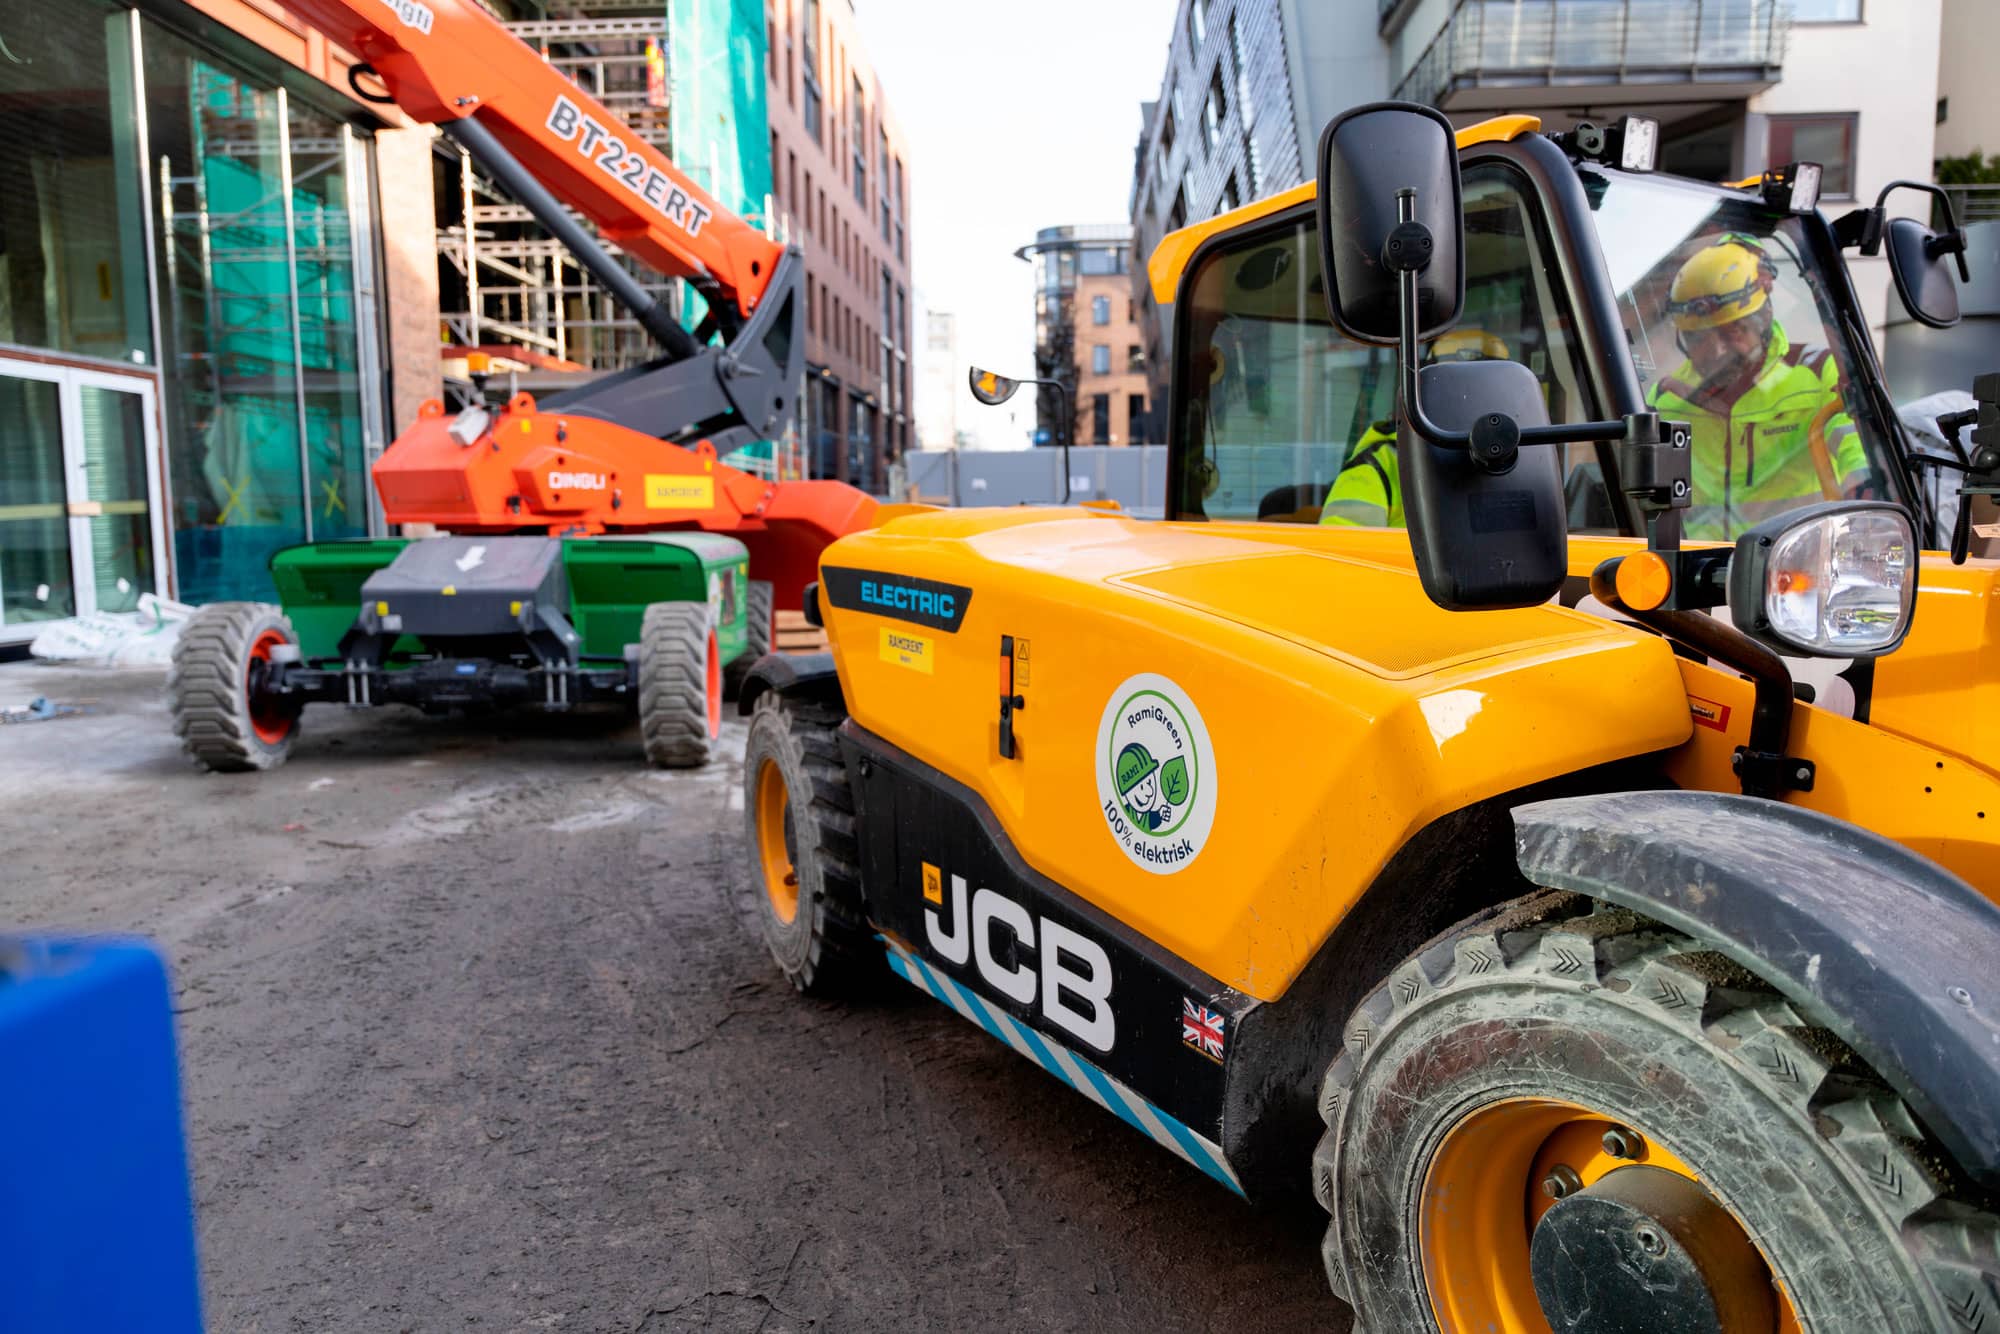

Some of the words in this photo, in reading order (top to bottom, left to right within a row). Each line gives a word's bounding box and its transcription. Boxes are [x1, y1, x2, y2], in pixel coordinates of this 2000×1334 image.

[550, 101, 708, 231] BT22ERT
[548, 472, 606, 490] DINGLI
[860, 580, 955, 618] ELECTRIC
[1127, 705, 1183, 750] RamiGreen
[1121, 764, 1140, 785] RAMI
[1104, 799, 1132, 847] 100%
[1134, 838, 1194, 864] elektrisk
[924, 873, 1116, 1052] JCB
